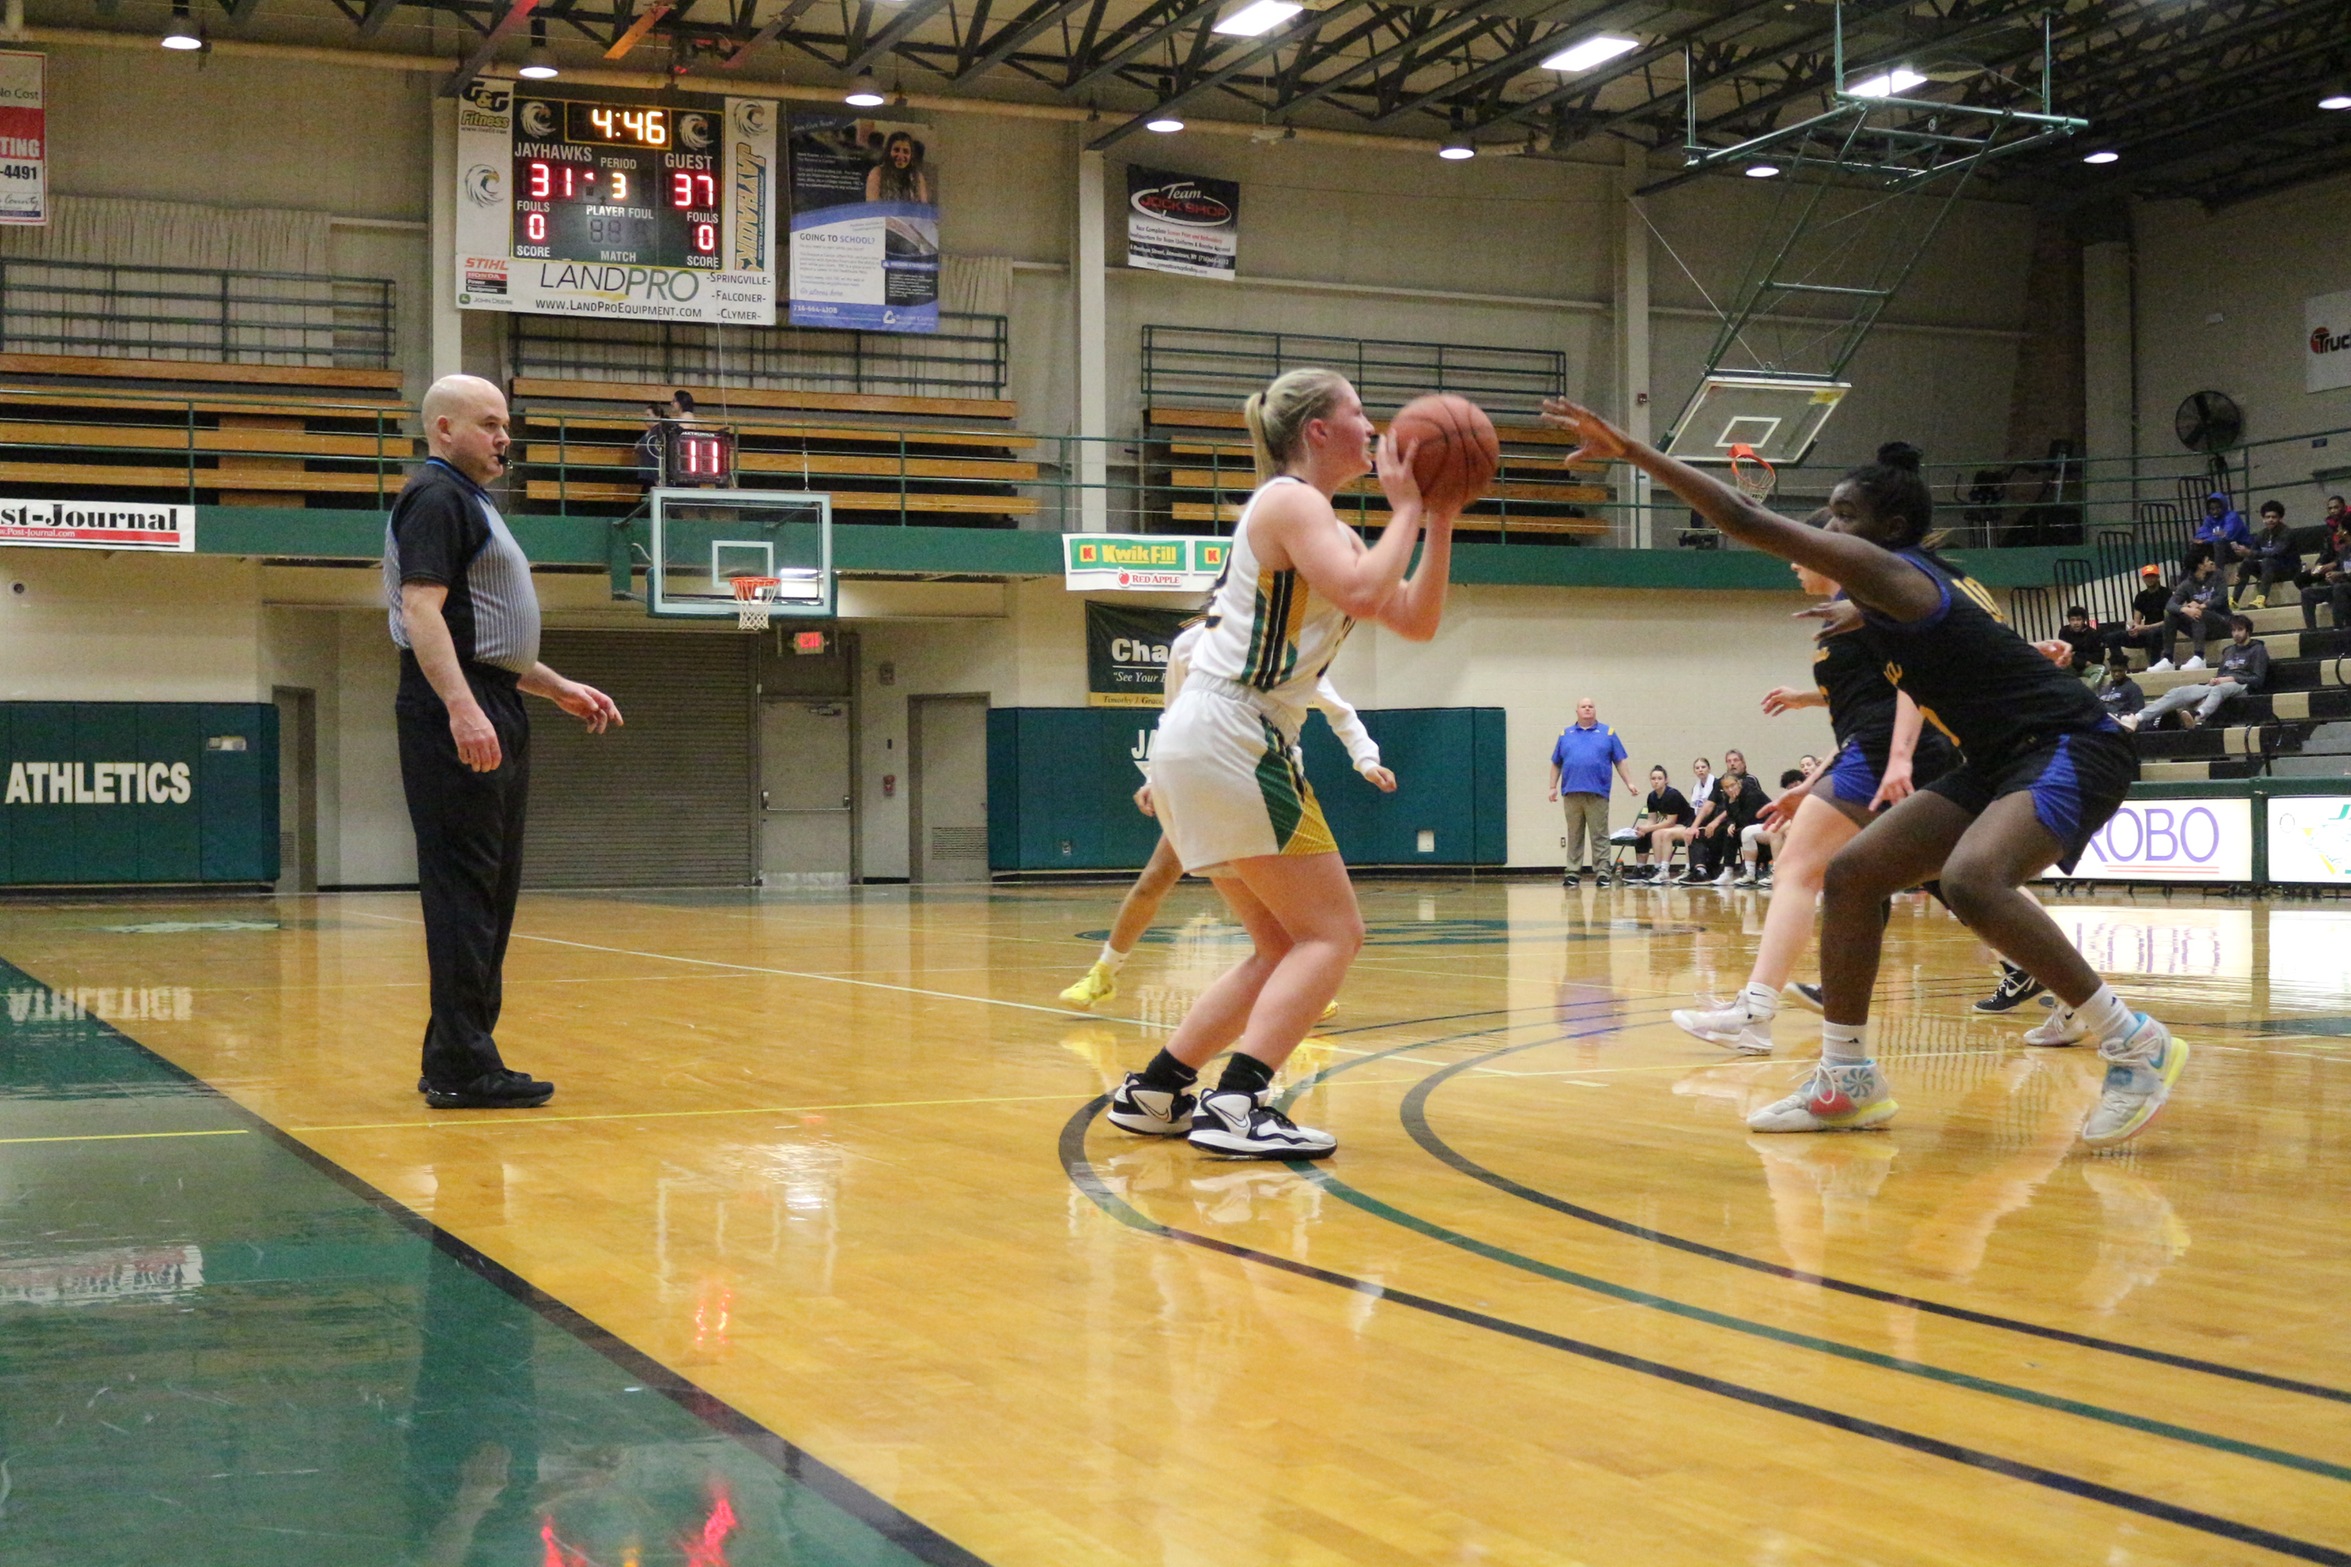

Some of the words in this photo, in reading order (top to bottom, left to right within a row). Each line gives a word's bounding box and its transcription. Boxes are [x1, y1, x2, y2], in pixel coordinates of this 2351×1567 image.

[14, 88, 39, 100] Cost
[461, 110, 510, 129] Fitness
[592, 108, 666, 144] 4:46
[515, 142, 593, 162] JAYHAWKS
[601, 157, 637, 170] PERIOD
[665, 153, 713, 170] GUEST
[532, 163, 573, 197] 31
[612, 172, 627, 199] 3
[675, 173, 714, 206] 37
[1160, 182, 1202, 199] Team
[517, 200, 550, 213] FOULS
[586, 205, 625, 217] PLAYER
[629, 207, 654, 220] FOUL
[1140, 196, 1182, 211] JOCK
[1185, 203, 1227, 217] SHOP
[687, 211, 719, 224] FOULS
[528, 214, 544, 239] 0
[699, 225, 714, 250] 0
[800, 233, 825, 242] GOING
[828, 235, 838, 243] TO
[840, 235, 876, 245] SCHOOL?
[516, 245, 550, 258] SCORE
[600, 250, 637, 263] MATCH
[465, 257, 509, 271] STIHL
[687, 255, 719, 268] SCORE
[540, 263, 700, 302] LANDPRO
[690, 440, 718, 473] 11
[0, 503, 179, 531] st-Journal
[1132, 574, 1150, 583] RED
[1152, 574, 1180, 584] APPLE
[1135, 671, 1159, 682] Your
[5, 762, 192, 804] ATHLETICS
